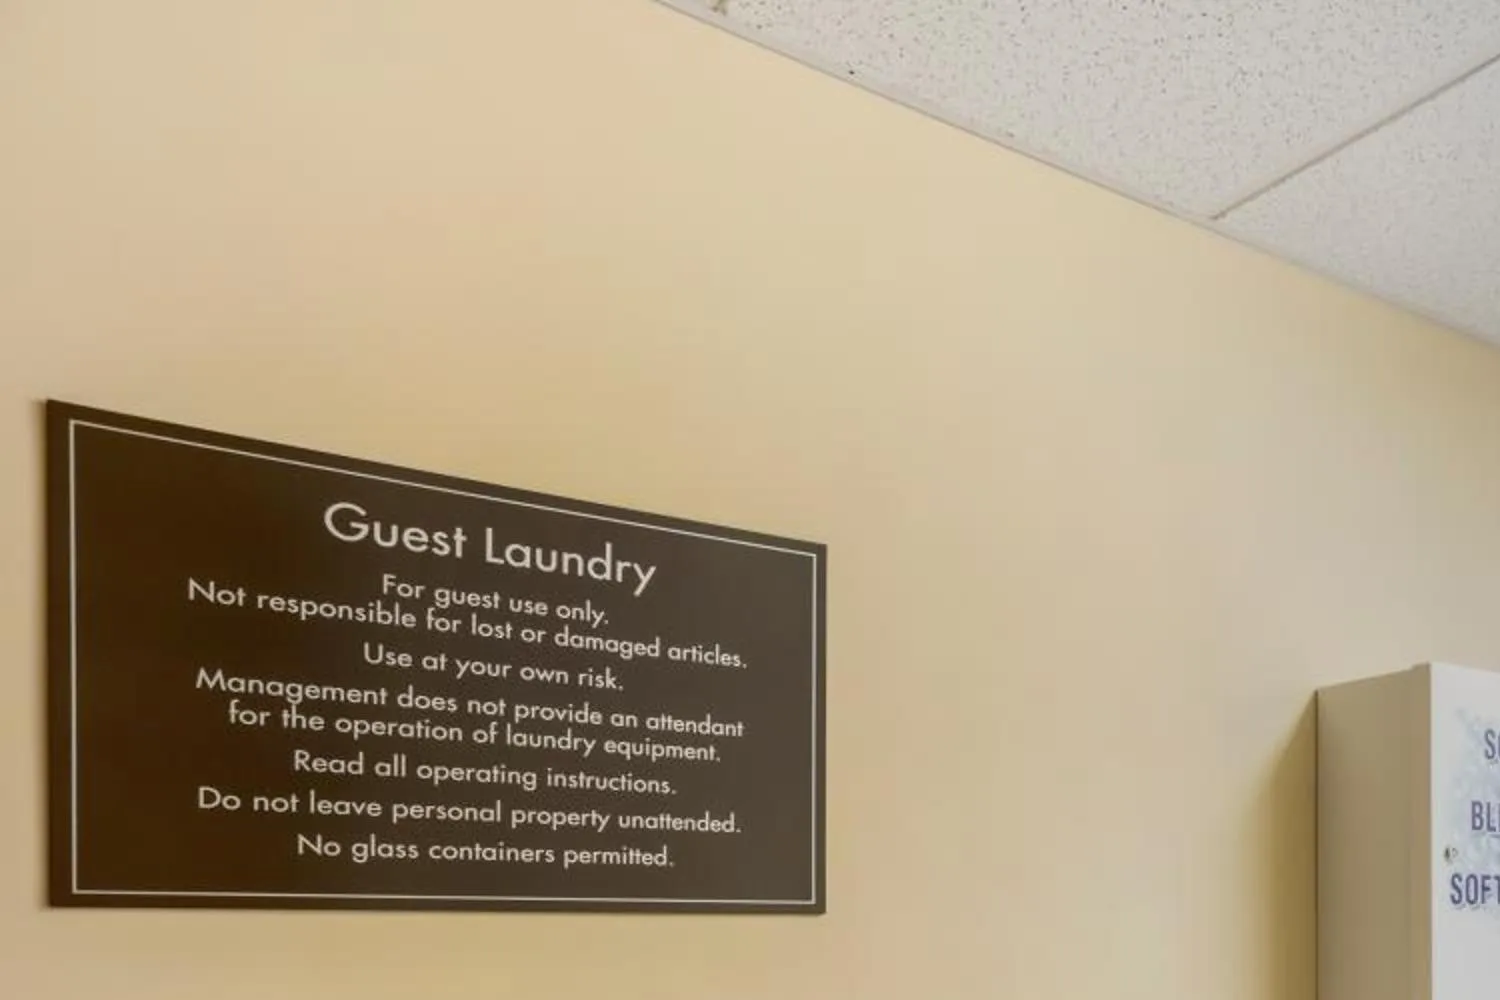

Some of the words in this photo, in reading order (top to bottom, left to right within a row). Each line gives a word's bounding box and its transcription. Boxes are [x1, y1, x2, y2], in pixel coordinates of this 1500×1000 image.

[324, 501, 468, 559] Guest
[485, 527, 657, 597] Laundry
[188, 577, 246, 607] Not
[257, 595, 417, 628] responsible
[426, 606, 462, 633] for
[471, 612, 513, 640] lost
[519, 628, 547, 644] or
[553, 624, 661, 660] damaged
[666, 643, 748, 669] articles.
[382, 573, 426, 599] For
[433, 588, 501, 609] guest
[509, 597, 549, 617] use
[555, 599, 609, 629] only.
[363, 642, 413, 668] Use
[421, 653, 448, 671] at
[455, 659, 513, 680] your
[519, 666, 569, 685] own
[578, 666, 624, 691] risk.
[195, 667, 388, 705] Management
[396, 684, 458, 713] does
[467, 698, 507, 716] not
[514, 701, 603, 725] provide
[609, 713, 639, 729] an
[645, 713, 745, 737] attendant
[229, 698, 271, 726] for
[281, 702, 325, 731] the
[335, 718, 463, 742] operation
[472, 720, 499, 744] of
[506, 722, 597, 758] laundry
[603, 737, 721, 763] equipment.
[294, 749, 364, 775] Read
[374, 753, 407, 777] all
[416, 764, 537, 792] operating
[547, 767, 677, 795] instructions.
[198, 786, 241, 810] Do
[253, 794, 300, 813] not
[309, 789, 382, 817] leave
[392, 799, 502, 824] personal
[511, 809, 611, 833] property
[618, 810, 742, 833] unattended.
[297, 833, 341, 857] No
[351, 833, 419, 864] glass
[428, 841, 556, 863] containers
[563, 844, 674, 870] permitted.
